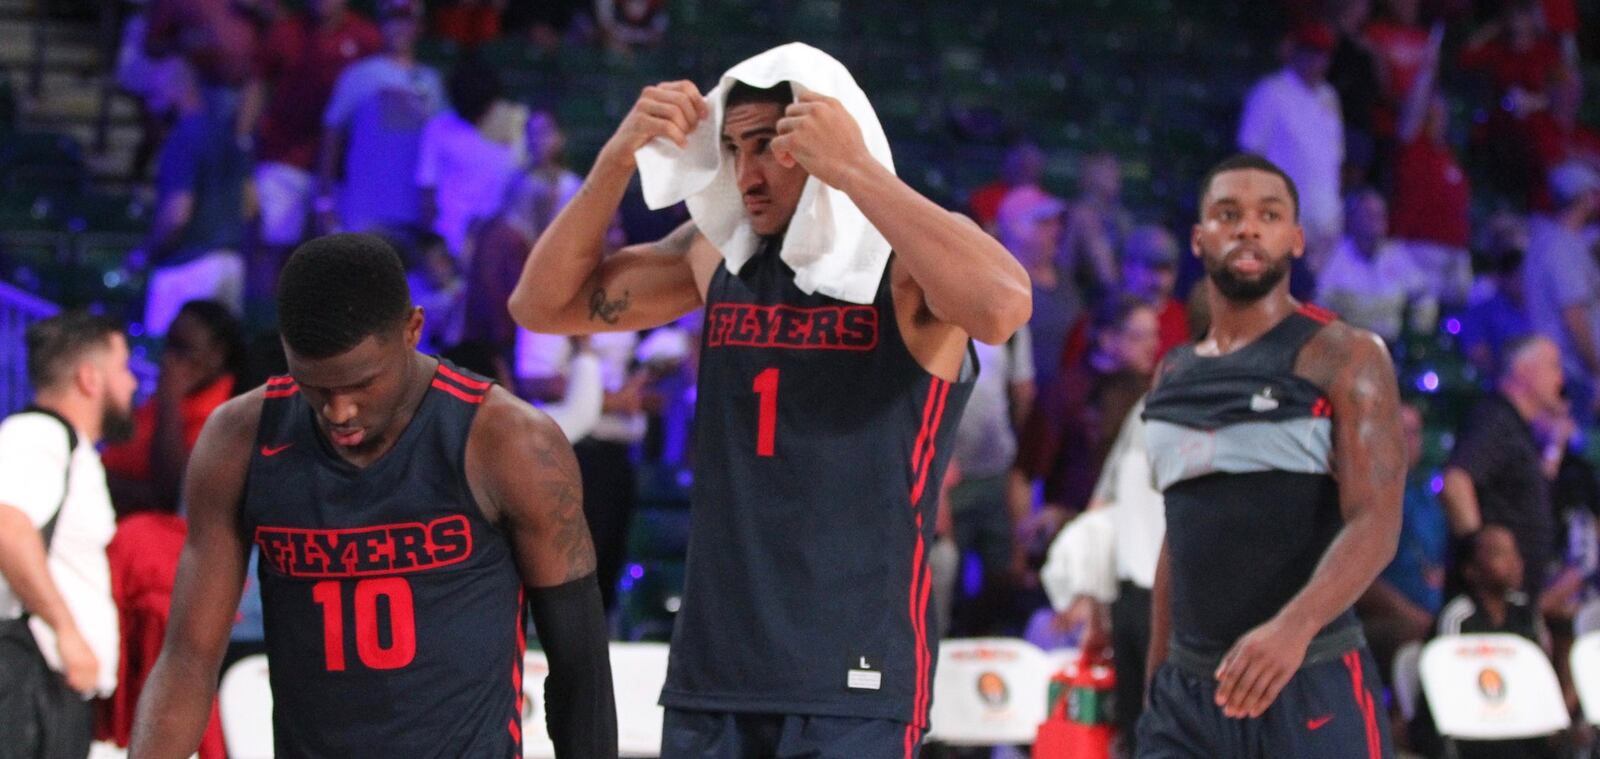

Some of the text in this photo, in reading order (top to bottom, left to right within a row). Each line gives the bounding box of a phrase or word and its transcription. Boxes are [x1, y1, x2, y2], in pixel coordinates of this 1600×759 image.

[708, 304, 878, 351] FLYERS
[752, 367, 779, 457] 1
[255, 515, 473, 577] FLYERS
[312, 577, 417, 671] 10
[860, 656, 871, 669] L
